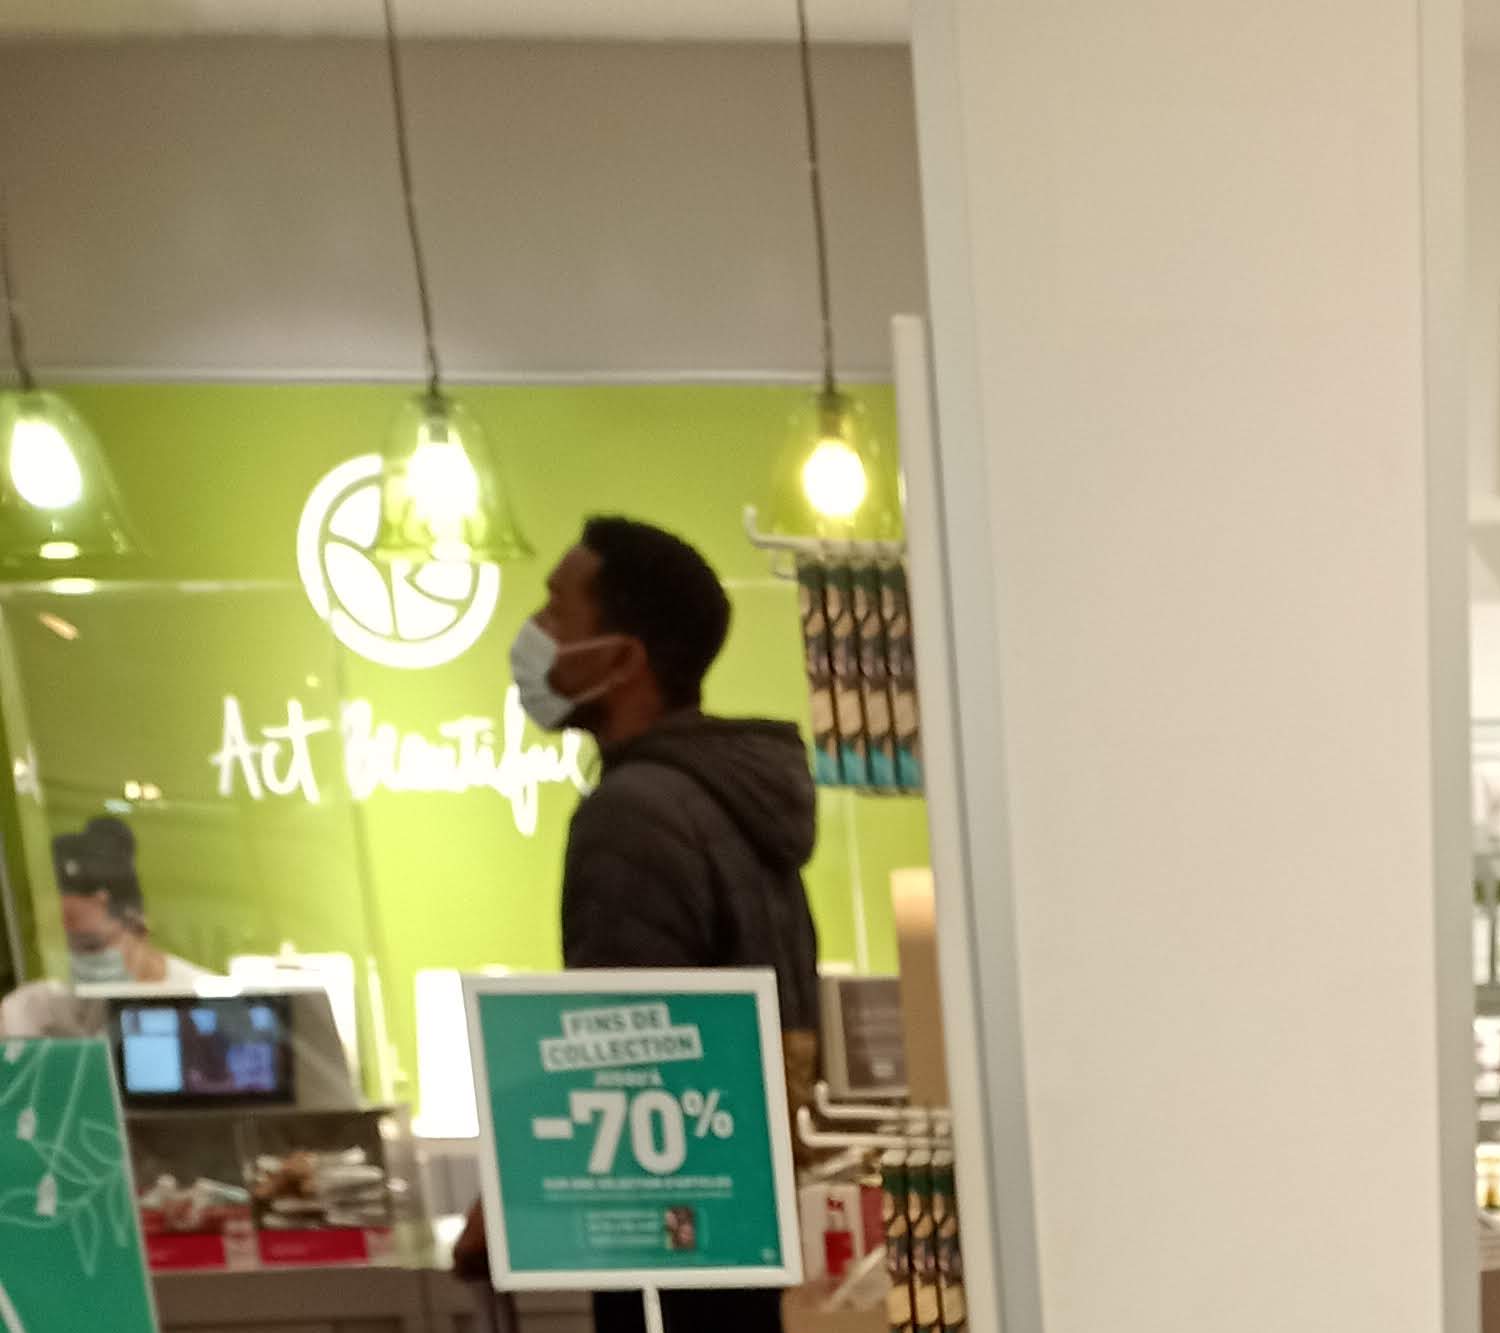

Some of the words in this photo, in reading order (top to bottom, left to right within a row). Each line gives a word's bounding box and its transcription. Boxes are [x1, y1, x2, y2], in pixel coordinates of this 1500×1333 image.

[211, 695, 331, 805] Act
[548, 1033, 694, 1066] COLLECTION
[570, 1013, 626, 1034] FINS
[630, 1009, 660, 1030] DE
[532, 1088, 734, 1176] -70%
